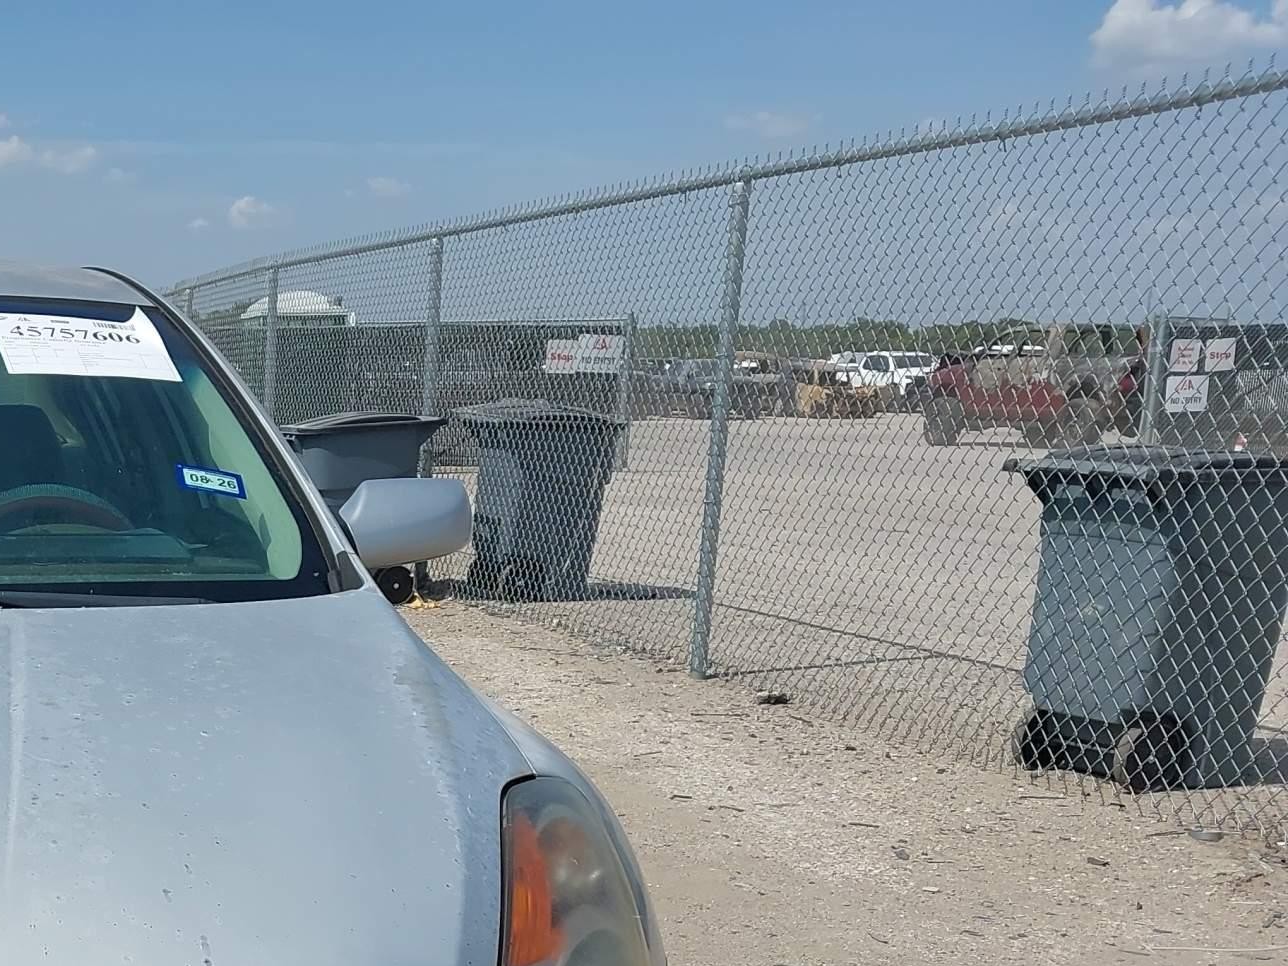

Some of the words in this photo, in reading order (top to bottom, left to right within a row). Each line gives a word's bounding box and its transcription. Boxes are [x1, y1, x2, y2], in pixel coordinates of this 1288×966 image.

[9, 325, 141, 344] 45757606
[550, 352, 573, 362] Stop
[1209, 351, 1231, 360] Stop
